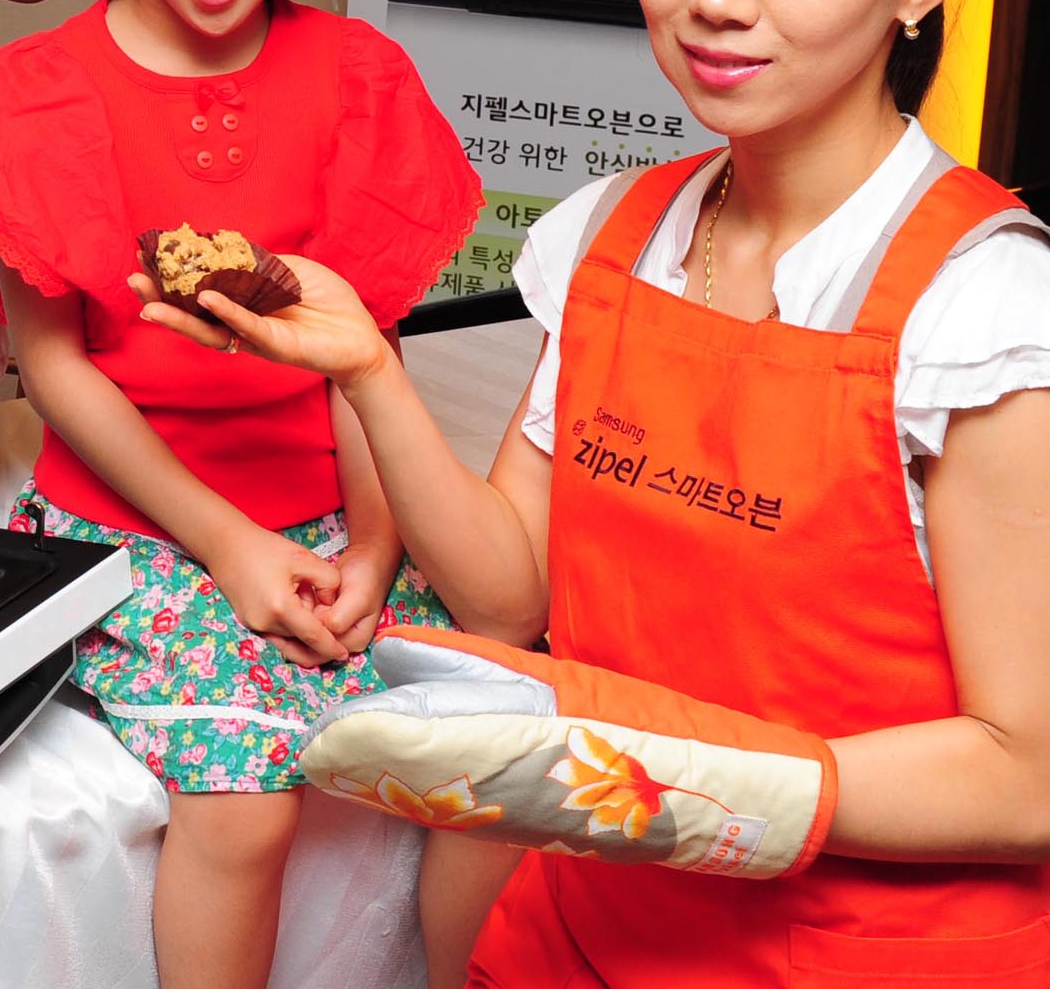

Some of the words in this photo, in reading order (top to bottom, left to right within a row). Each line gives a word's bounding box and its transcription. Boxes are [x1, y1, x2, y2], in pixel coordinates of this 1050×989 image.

[460, 93, 686, 138] 지펠스마트오븐으로
[463, 136, 510, 163] 건강
[518, 142, 568, 172] 위한
[495, 203, 543, 229] 아토
[593, 406, 646, 445] Samsung
[573, 436, 648, 488] zipel
[647, 467, 782, 532] 스마트오븐
